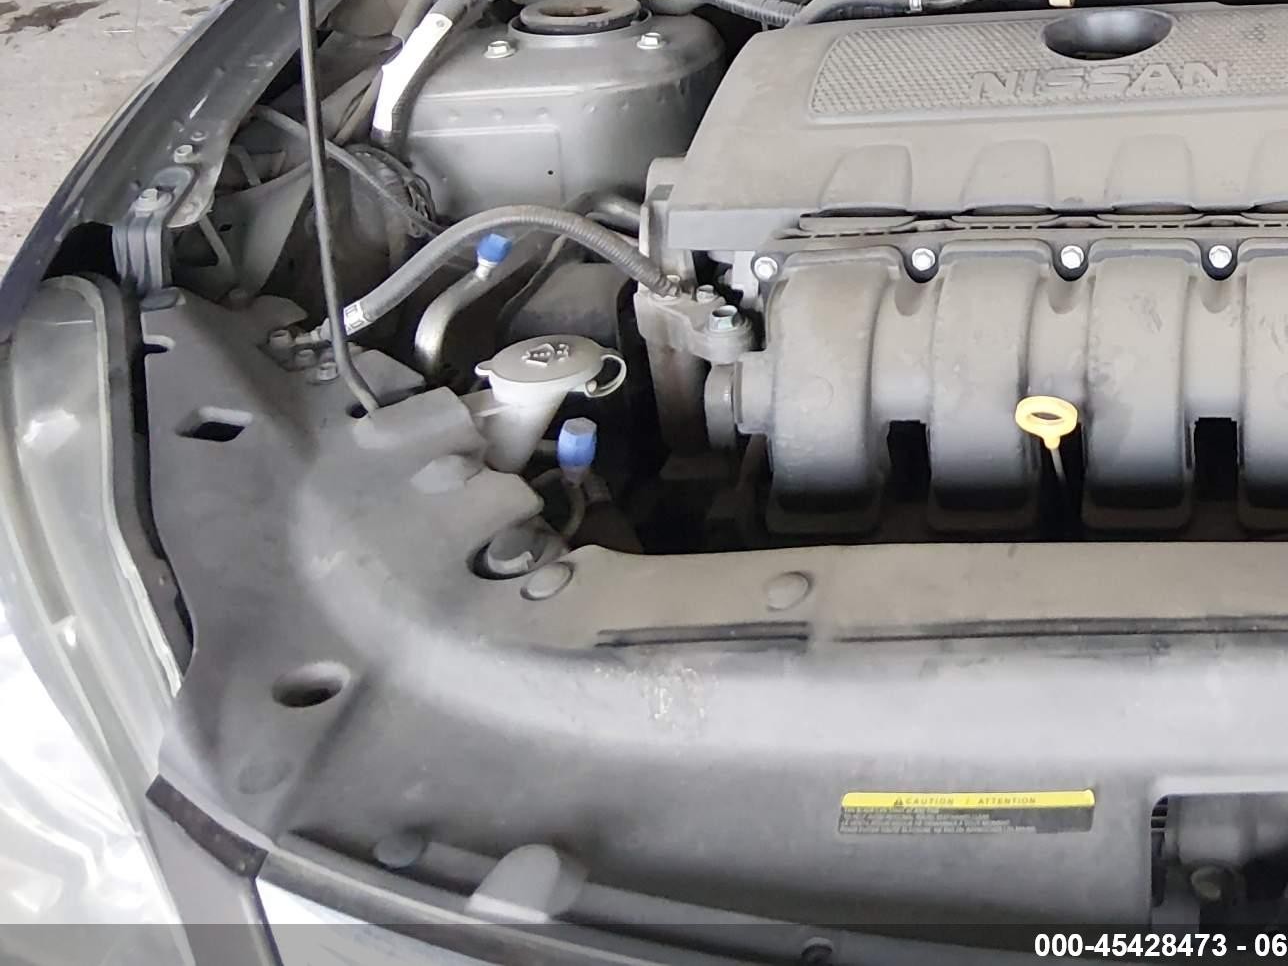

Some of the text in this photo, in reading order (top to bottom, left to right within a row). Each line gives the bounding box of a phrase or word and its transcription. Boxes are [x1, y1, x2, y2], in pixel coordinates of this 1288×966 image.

[970, 61, 1230, 99] NISSAN
[905, 797, 955, 805] CAUTION
[977, 796, 1037, 805] ATTENTION
